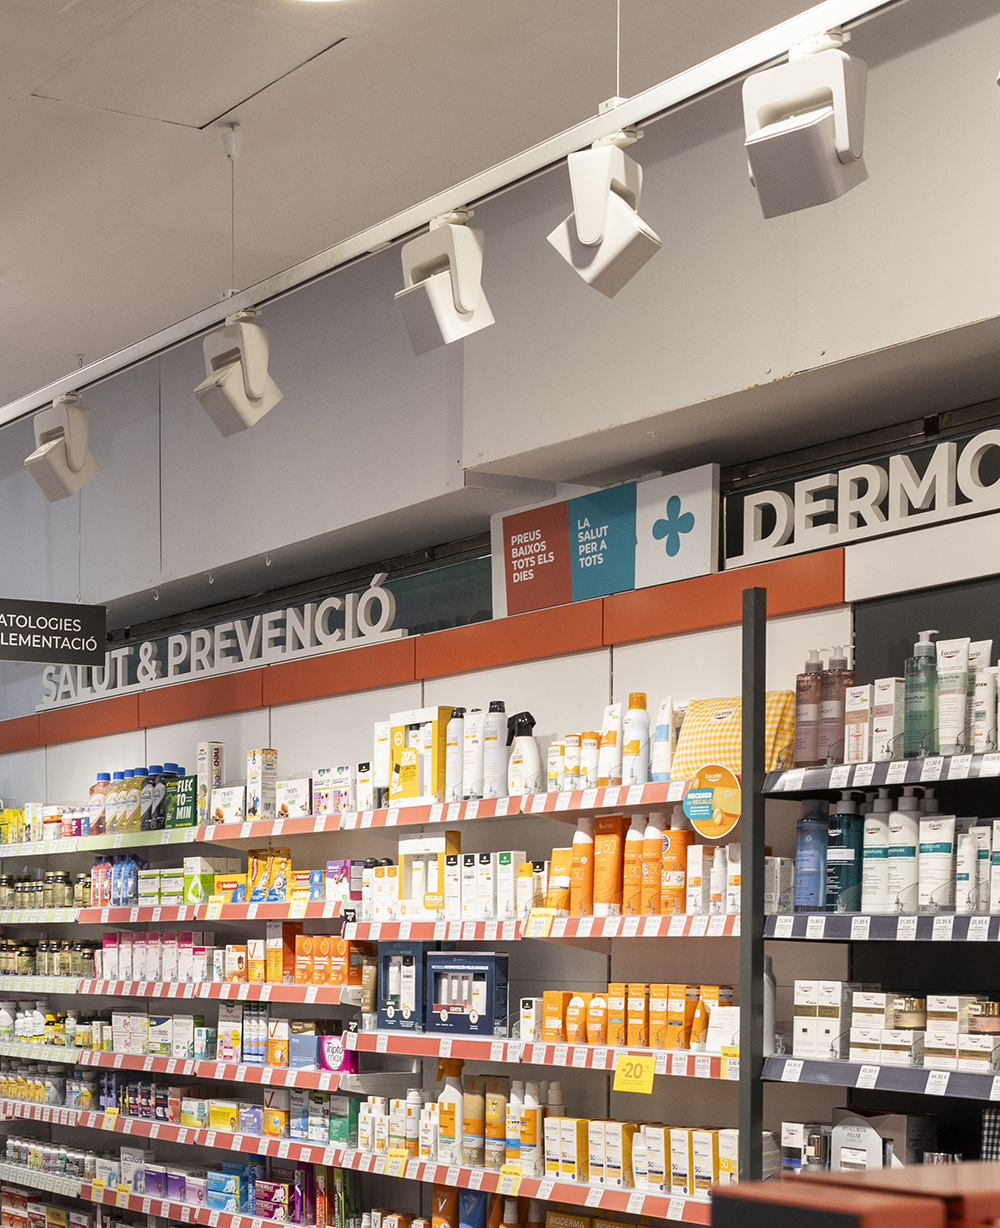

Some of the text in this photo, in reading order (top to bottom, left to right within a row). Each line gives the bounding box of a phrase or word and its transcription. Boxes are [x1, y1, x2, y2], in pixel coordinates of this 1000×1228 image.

[577, 517, 590, 530] LA
[511, 529, 542, 546] PREUS
[578, 525, 609, 543] SALUT
[511, 541, 547, 558] BAIXOS
[579, 539, 608, 555] PER A
[512, 552, 555, 570] TOTS ELS
[579, 553, 604, 568] TOTS
[513, 569, 535, 583] DIES
[42, 572, 397, 704] SALUT & PREVENCIÓ
[940, 648, 960, 657] Eucerin
[177, 778, 193, 793] FLEC
[176, 793, 186, 805] TO
[687, 791, 713, 799] NECESER
[176, 805, 192, 820] MIN
[621, 1062, 643, 1079] -20
